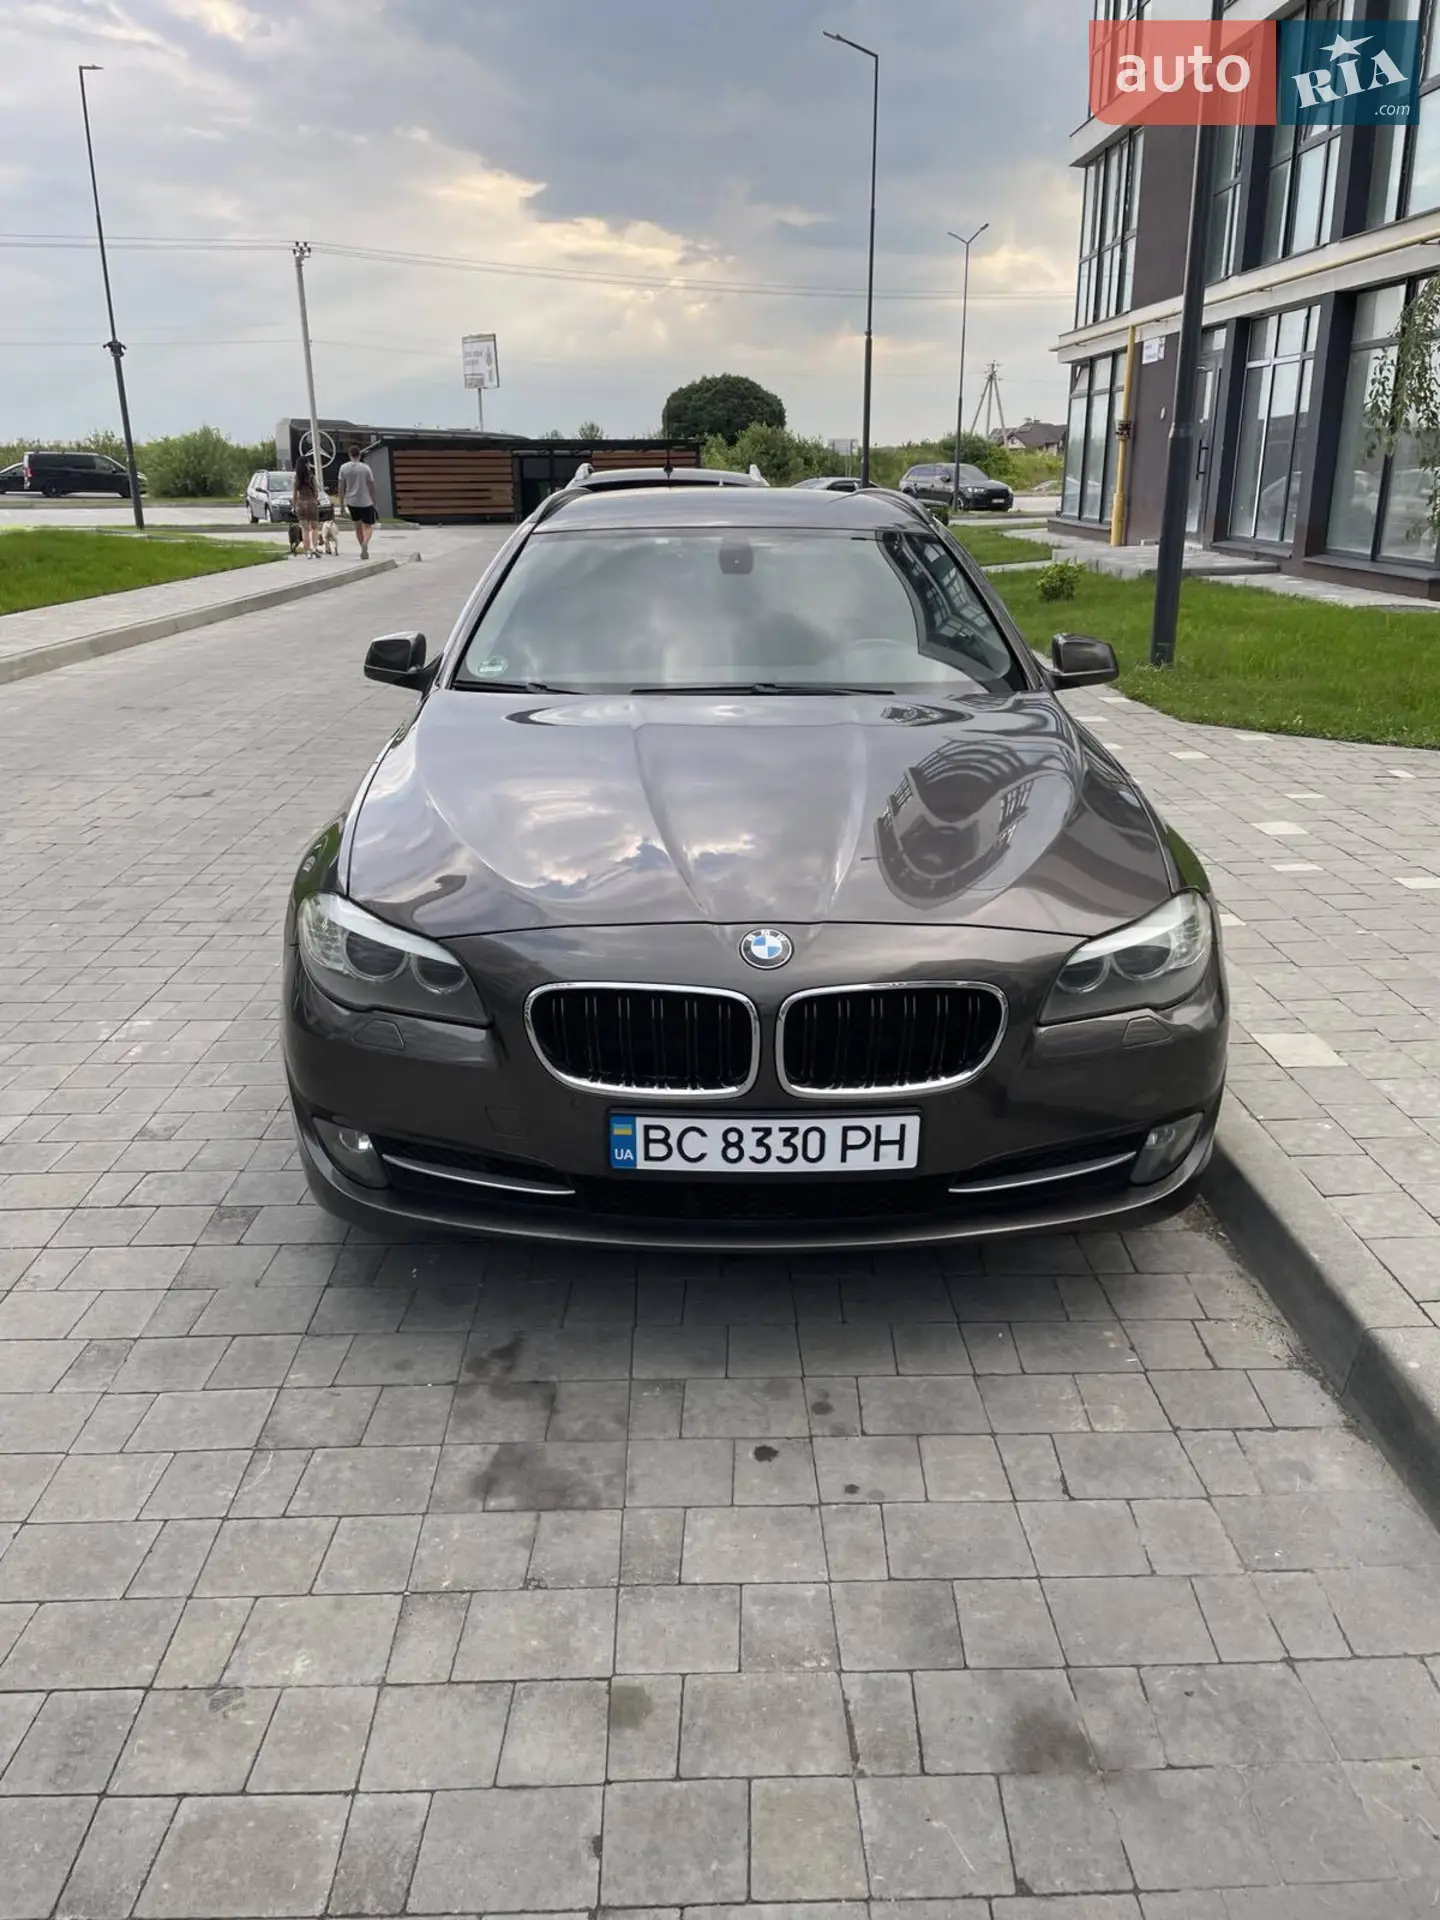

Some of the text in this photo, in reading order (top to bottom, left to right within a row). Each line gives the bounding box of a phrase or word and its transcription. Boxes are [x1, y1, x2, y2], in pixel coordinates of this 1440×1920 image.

[746, 929, 788, 941] BMW
[643, 1124, 907, 1164] BC 8330 PH
[614, 1148, 634, 1161] UA
